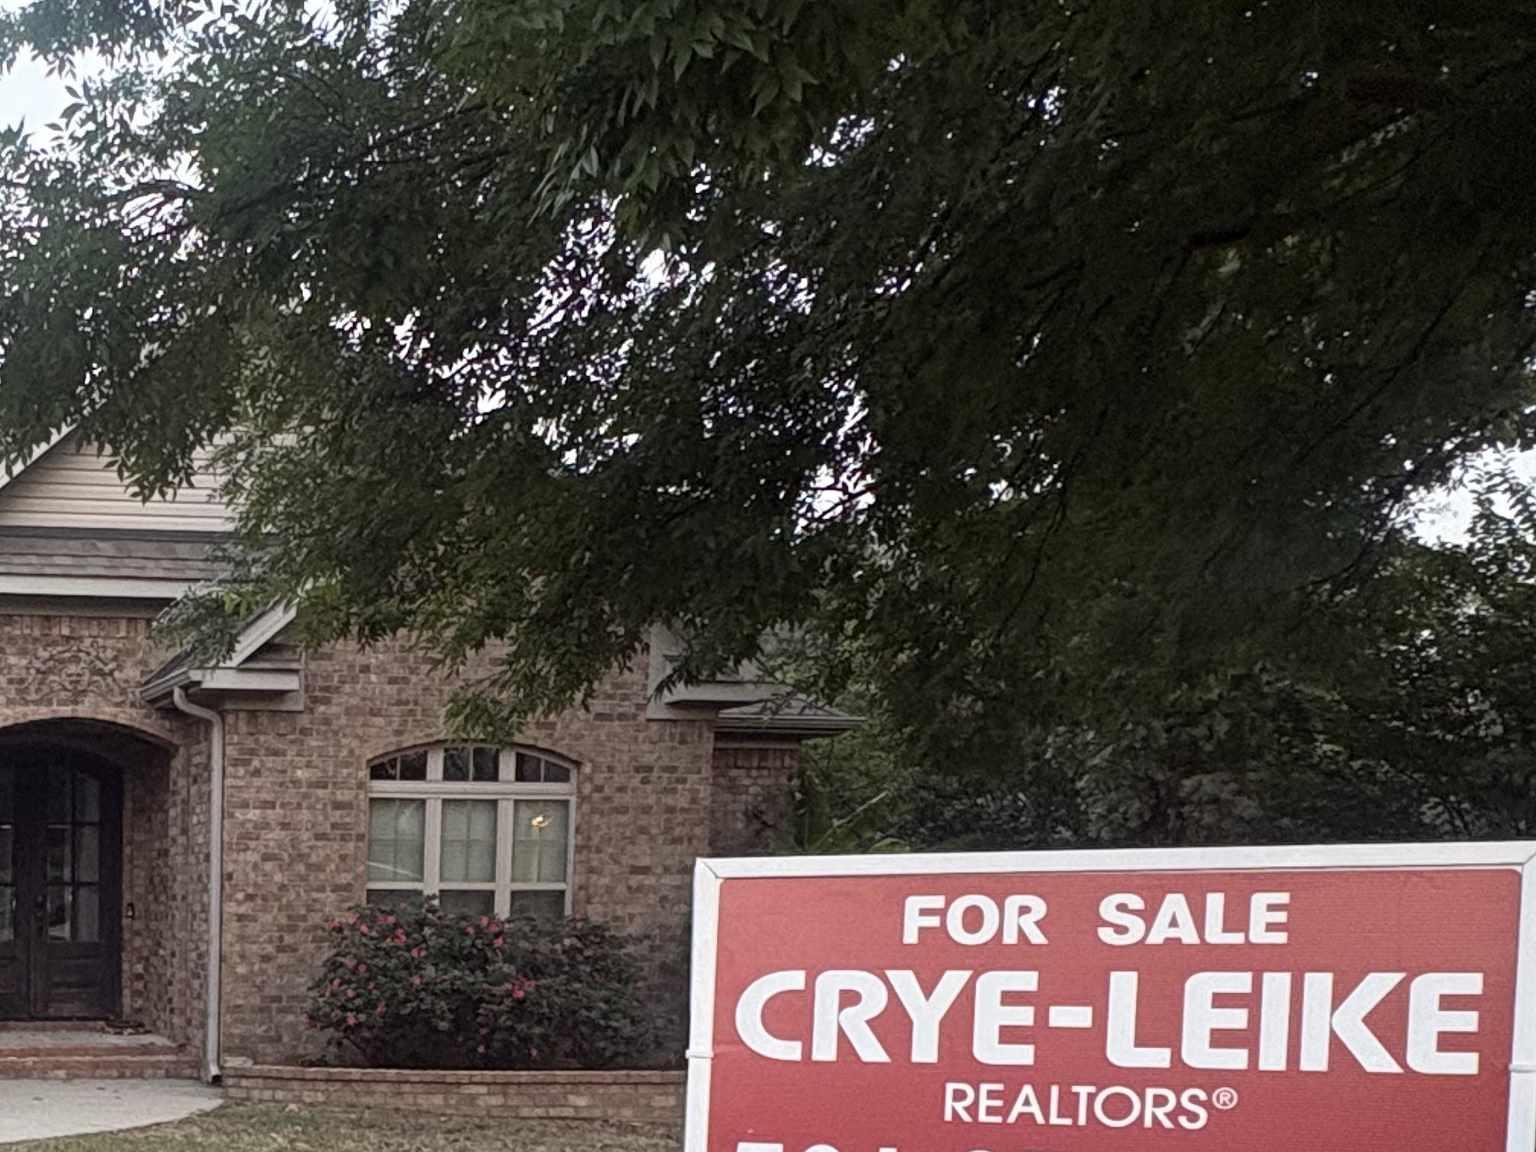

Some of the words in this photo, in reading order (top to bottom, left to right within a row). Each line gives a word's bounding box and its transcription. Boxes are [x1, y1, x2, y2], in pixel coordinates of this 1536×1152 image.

[901, 893, 1049, 946] FOR
[1096, 891, 1291, 946] SALE
[734, 968, 1484, 1075] CRYE-LEIKE
